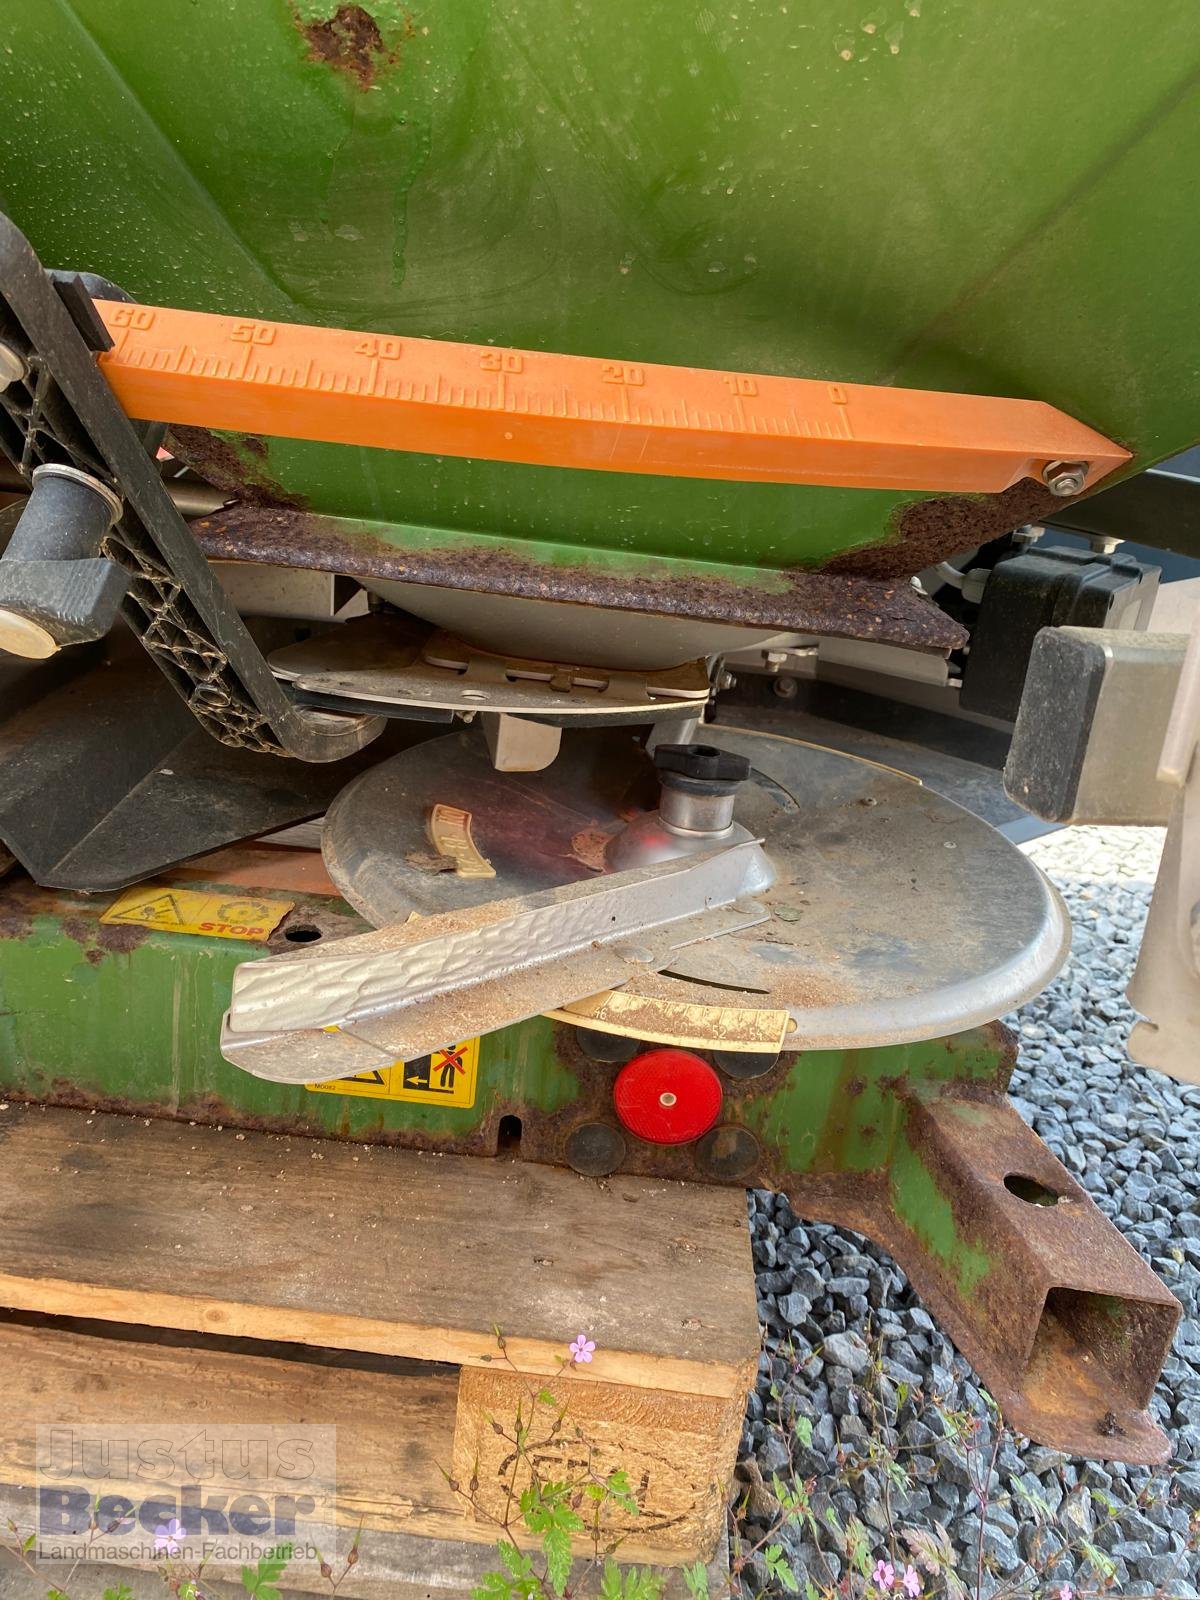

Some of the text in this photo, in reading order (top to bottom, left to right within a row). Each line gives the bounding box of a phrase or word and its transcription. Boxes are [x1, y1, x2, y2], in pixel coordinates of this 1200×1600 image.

[109, 308, 848, 406] 60 50 40 30 20 10 0
[198, 922, 265, 937] STOP
[711, 1024, 728, 1040] 52
[748, 1028, 765, 1041] 54
